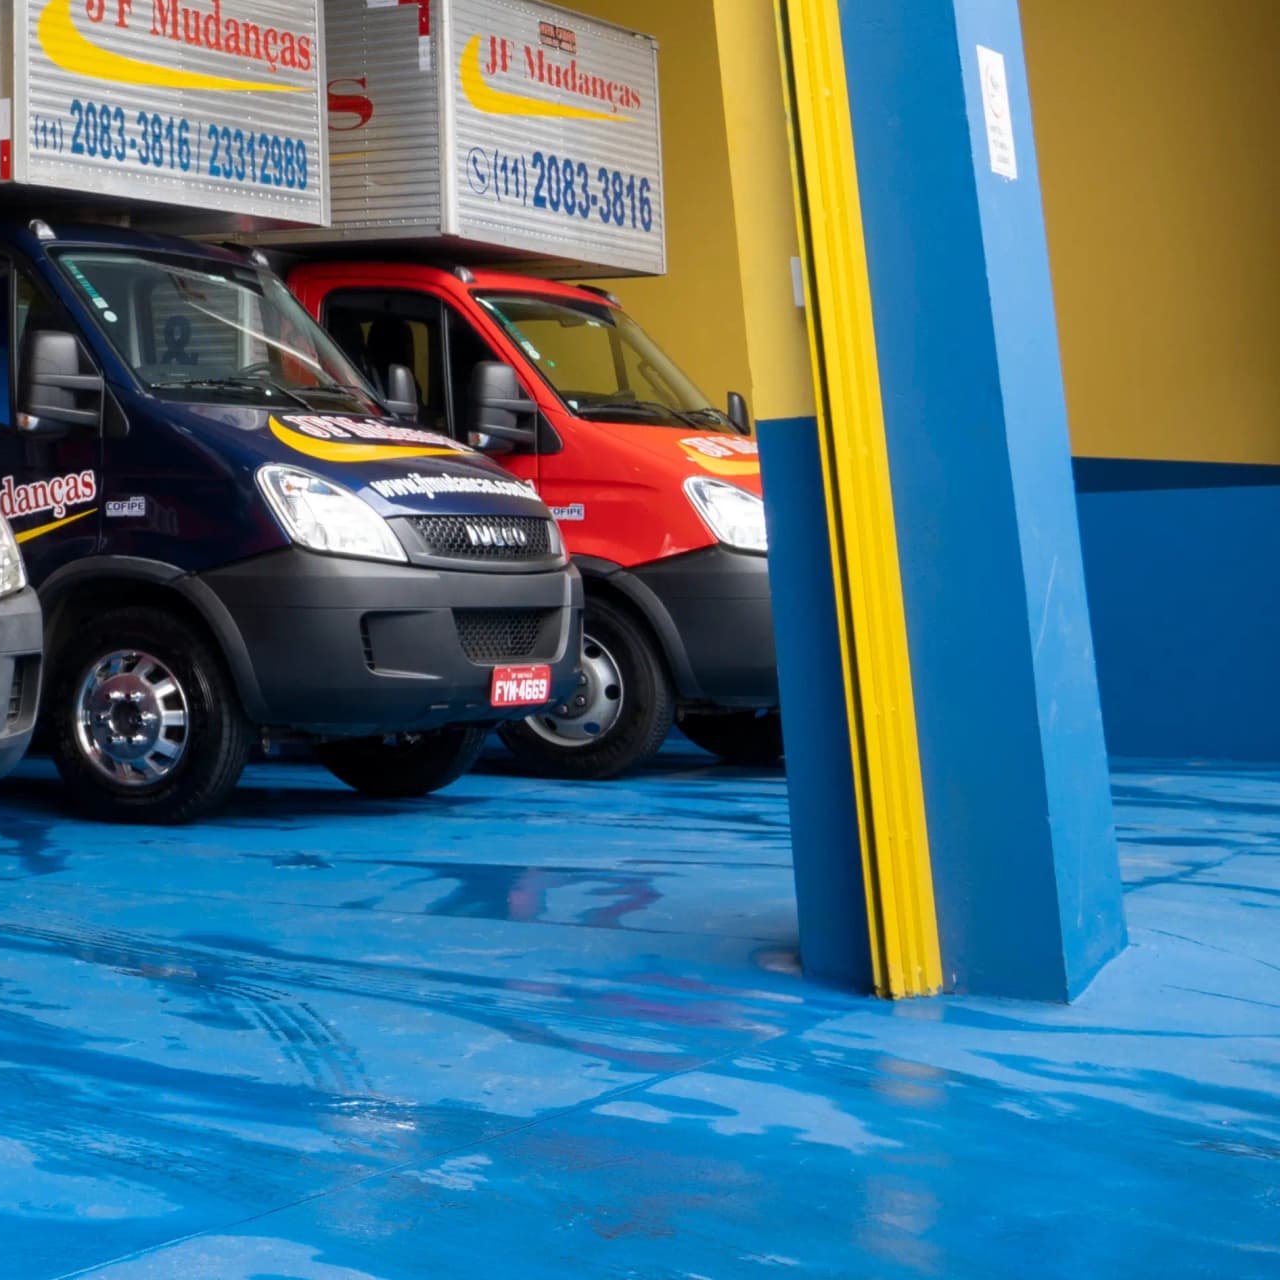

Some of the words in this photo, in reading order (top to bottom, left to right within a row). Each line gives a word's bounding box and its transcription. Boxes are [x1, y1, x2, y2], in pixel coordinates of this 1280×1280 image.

[524, 44, 642, 113] Mudanças
[34, 114, 64, 154] (11)
[70, 99, 190, 172] 2083-3816
[208, 123, 308, 190] 23312989
[494, 149, 528, 207] (11)
[532, 151, 653, 233] 2083-3816
[465, 523, 526, 547] IVECO
